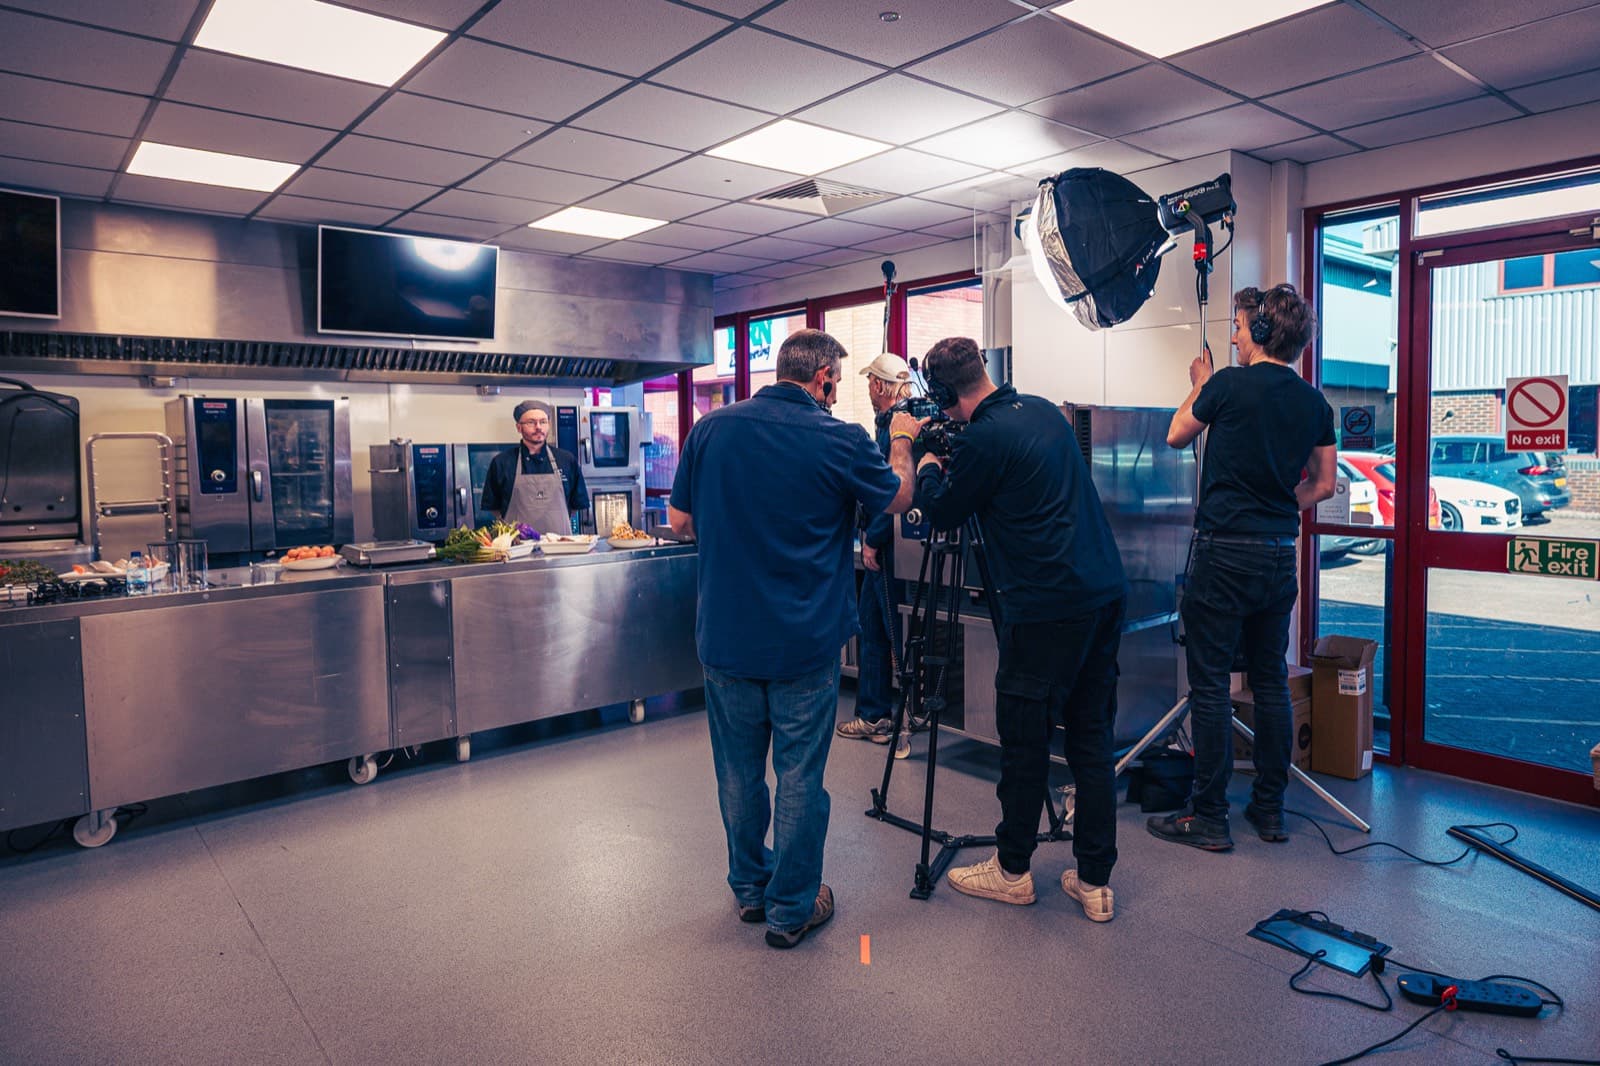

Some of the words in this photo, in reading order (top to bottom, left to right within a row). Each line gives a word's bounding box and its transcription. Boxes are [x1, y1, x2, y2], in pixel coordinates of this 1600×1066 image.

[1511, 434, 1531, 446] No
[1535, 434, 1561, 445] exit
[1547, 542, 1589, 560] Fire
[1547, 559, 1589, 576] exit
